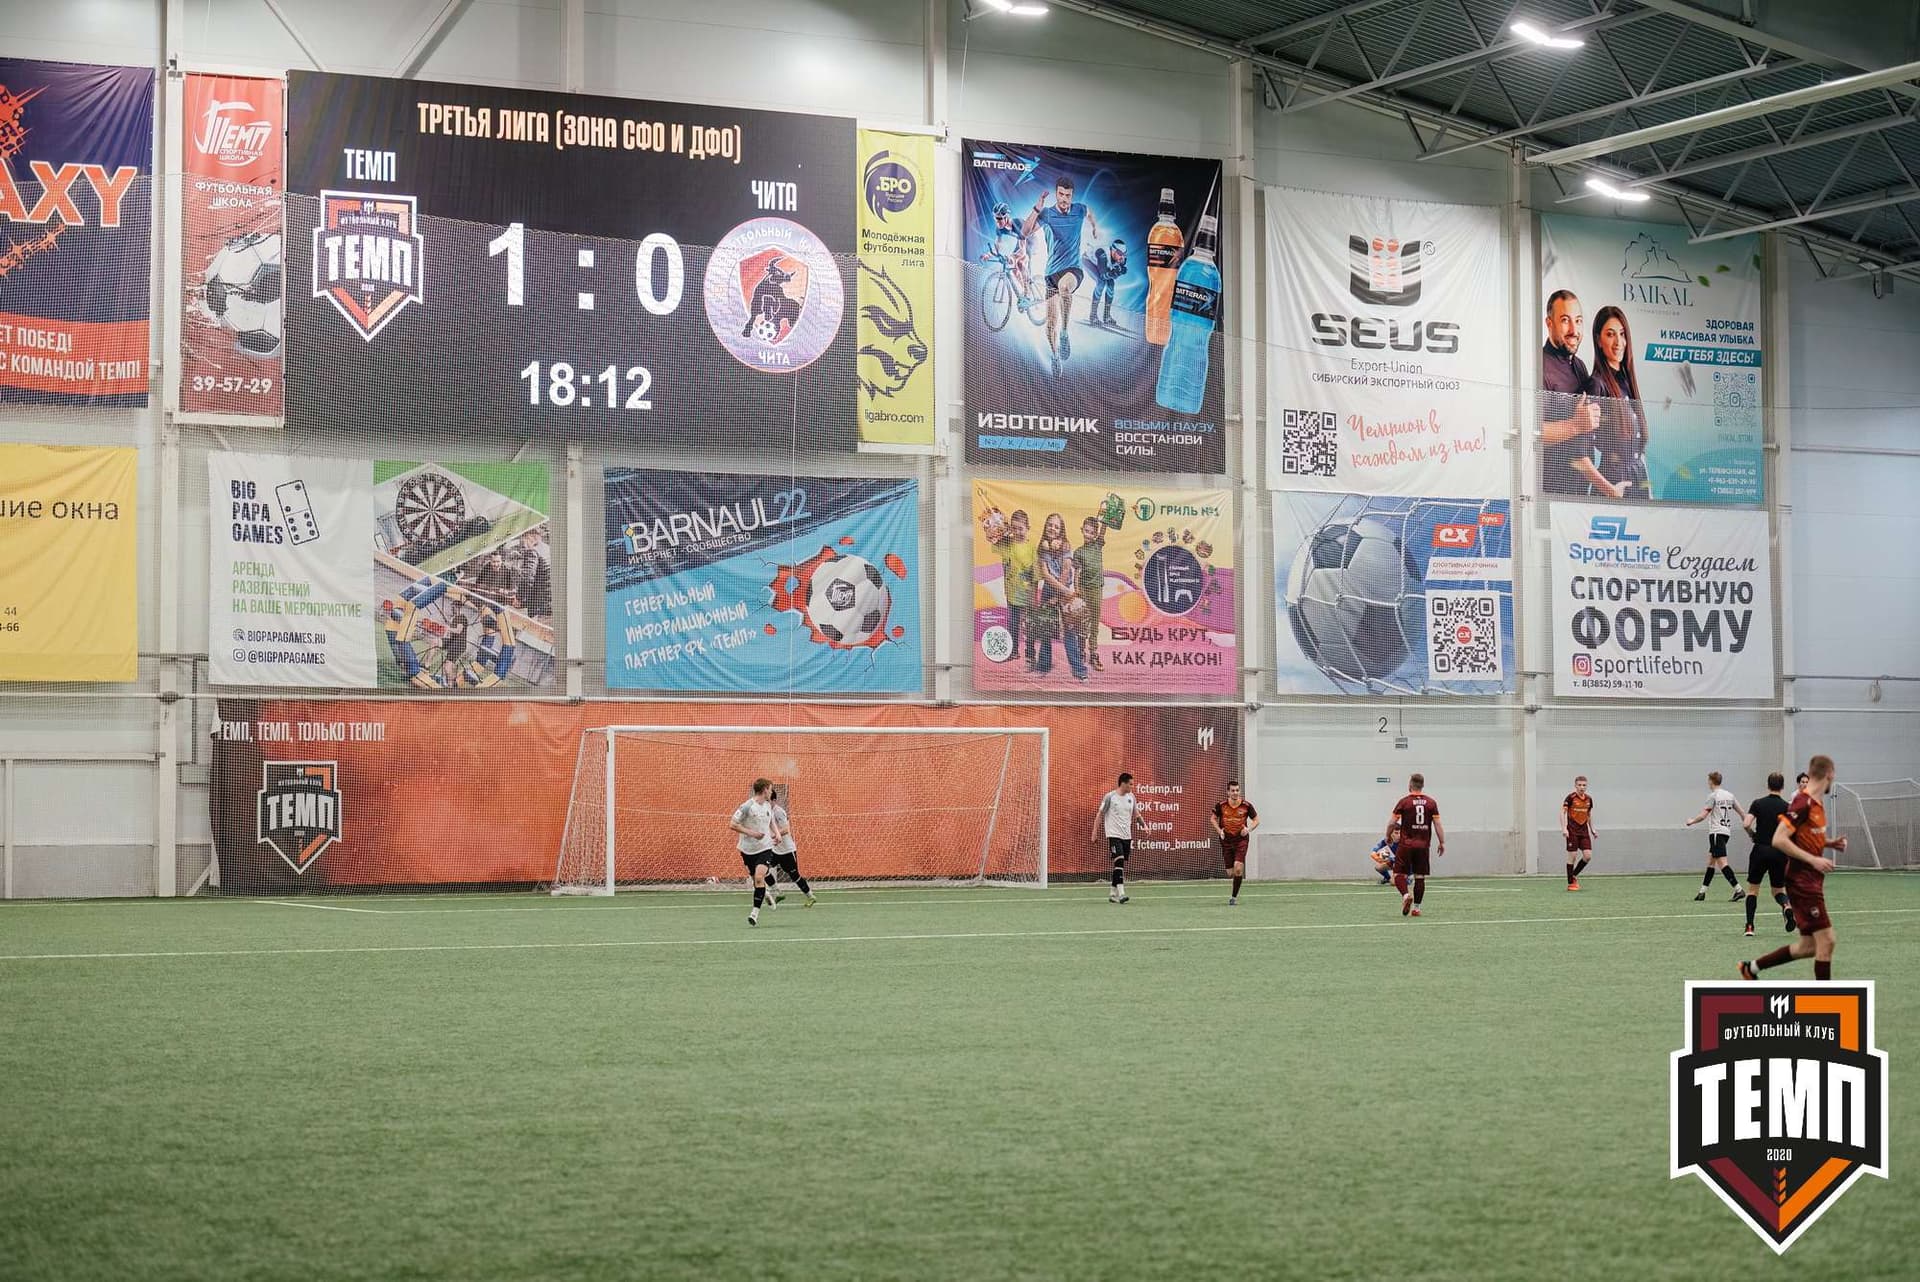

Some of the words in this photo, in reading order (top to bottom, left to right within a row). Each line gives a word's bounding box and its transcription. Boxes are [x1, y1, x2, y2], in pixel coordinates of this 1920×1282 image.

[417, 102, 491, 138] ТРЕТЬЯ
[497, 110, 549, 142] ЛИГА
[556, 110, 617, 150] (ЗОНА
[623, 119, 665, 152] СФО
[671, 124, 684, 154] И
[689, 125, 741, 164] ДФО)
[344, 148, 397, 182] ТЕМП
[973, 159, 1032, 171] BATTERADE
[195, 181, 273, 196] ФУТБОЛЬНАЯ
[751, 180, 797, 211] ЧИТА
[212, 196, 253, 208] ШКОЛА
[861, 228, 925, 244] Молодёжная
[863, 241, 925, 255] футбольная
[324, 234, 412, 287] ТЕМП
[489, 222, 524, 306] 1
[636, 232, 685, 316] 0
[1623, 283, 1694, 307] BAIKAL
[1311, 313, 1460, 353] SEUS
[1705, 319, 1754, 331] ЗДОРОВАЯ
[17, 327, 72, 353] ПОБЕД!
[1660, 329, 1667, 339] И
[1669, 330, 1717, 343] КРАСИВАЯ
[1719, 333, 1755, 345] УЛЫБКА
[758, 350, 791, 365] ЧИТА
[1653, 346, 1687, 361] ЖДЕТ
[1689, 349, 1714, 361] ТЕБЯ
[1717, 350, 1755, 364] ЗДЕСЬ!
[11, 353, 94, 381] КОМАНДОЙ
[98, 360, 140, 380] ТЕМП!
[1351, 358, 1423, 375] Export-Union
[193, 375, 272, 393] 39-57-29
[520, 361, 653, 410] 18:12
[1312, 372, 1368, 385] СИБИРСКИЙ
[1370, 377, 1433, 390] ЭКСПОРТНЫЙ
[1435, 380, 1460, 390] СОЮЗ
[978, 412, 1099, 434] ИЗОТОНИК
[1347, 413, 1427, 441] Чемпион
[1428, 409, 1441, 433] в
[1115, 432, 1203, 445] ВОССТАНОВИ
[1351, 439, 1426, 468] каждом
[1429, 447, 1449, 465] из
[1453, 427, 1487, 453] нас!
[1115, 444, 1157, 456] СИЛЫ.
[231, 480, 257, 500] BIG
[0, 500, 42, 518] ие
[52, 501, 119, 520] окна
[231, 502, 271, 522] PAPA
[1160, 505, 1198, 516] ГРИЛЬ
[232, 523, 284, 544] GAMES
[1588, 516, 1640, 541] SL
[628, 548, 678, 564] ИНТЕРНЕТ
[686, 532, 752, 553] СООБЩЕСТВО
[1569, 543, 1661, 564] SportLife
[232, 560, 275, 578] АРЕНДА
[1666, 546, 1758, 578] Создаем
[232, 581, 311, 597] РАЗВЛЕЧЕНИЙ
[625, 581, 716, 617] ГЕНЕРАЛЬНЫЙ
[1571, 576, 1753, 604] СПОРТИВНУЮ
[232, 599, 247, 613] НА
[250, 600, 281, 614] ВАШЕ
[284, 602, 362, 618] МЕРОПРИЯТИЕ
[0, 622, 20, 632] -66
[625, 602, 749, 645] ИНФОРМАЦИОННЫЙ
[1571, 606, 1753, 653] ФОРМУ
[247, 630, 326, 644] BIGPAPAGAMES.RU
[1111, 627, 1164, 643] БУДЬ
[1168, 627, 1212, 645] КРУТ,
[247, 651, 326, 665] @BIGPAPAGAMES
[625, 647, 681, 671] ПАРТНЕР
[685, 640, 705, 656] ФК
[709, 628, 757, 650] «ТЕМП»
[1112, 651, 1146, 665] КАК
[1150, 651, 1222, 668] ДРАКОН!
[1594, 656, 1703, 677] sportlifebrn
[257, 722, 294, 743] ТЕМП,
[297, 722, 345, 741] ТОЛЬКО
[349, 722, 385, 741] ТЕМП!
[1379, 716, 1388, 733] 2
[1136, 784, 1183, 796] fctemp.ru
[266, 792, 335, 831] ТЕМП
[1154, 802, 1180, 812] Темп
[1415, 805, 1425, 825] 8
[1137, 838, 1211, 851] fctemp_barnaul
